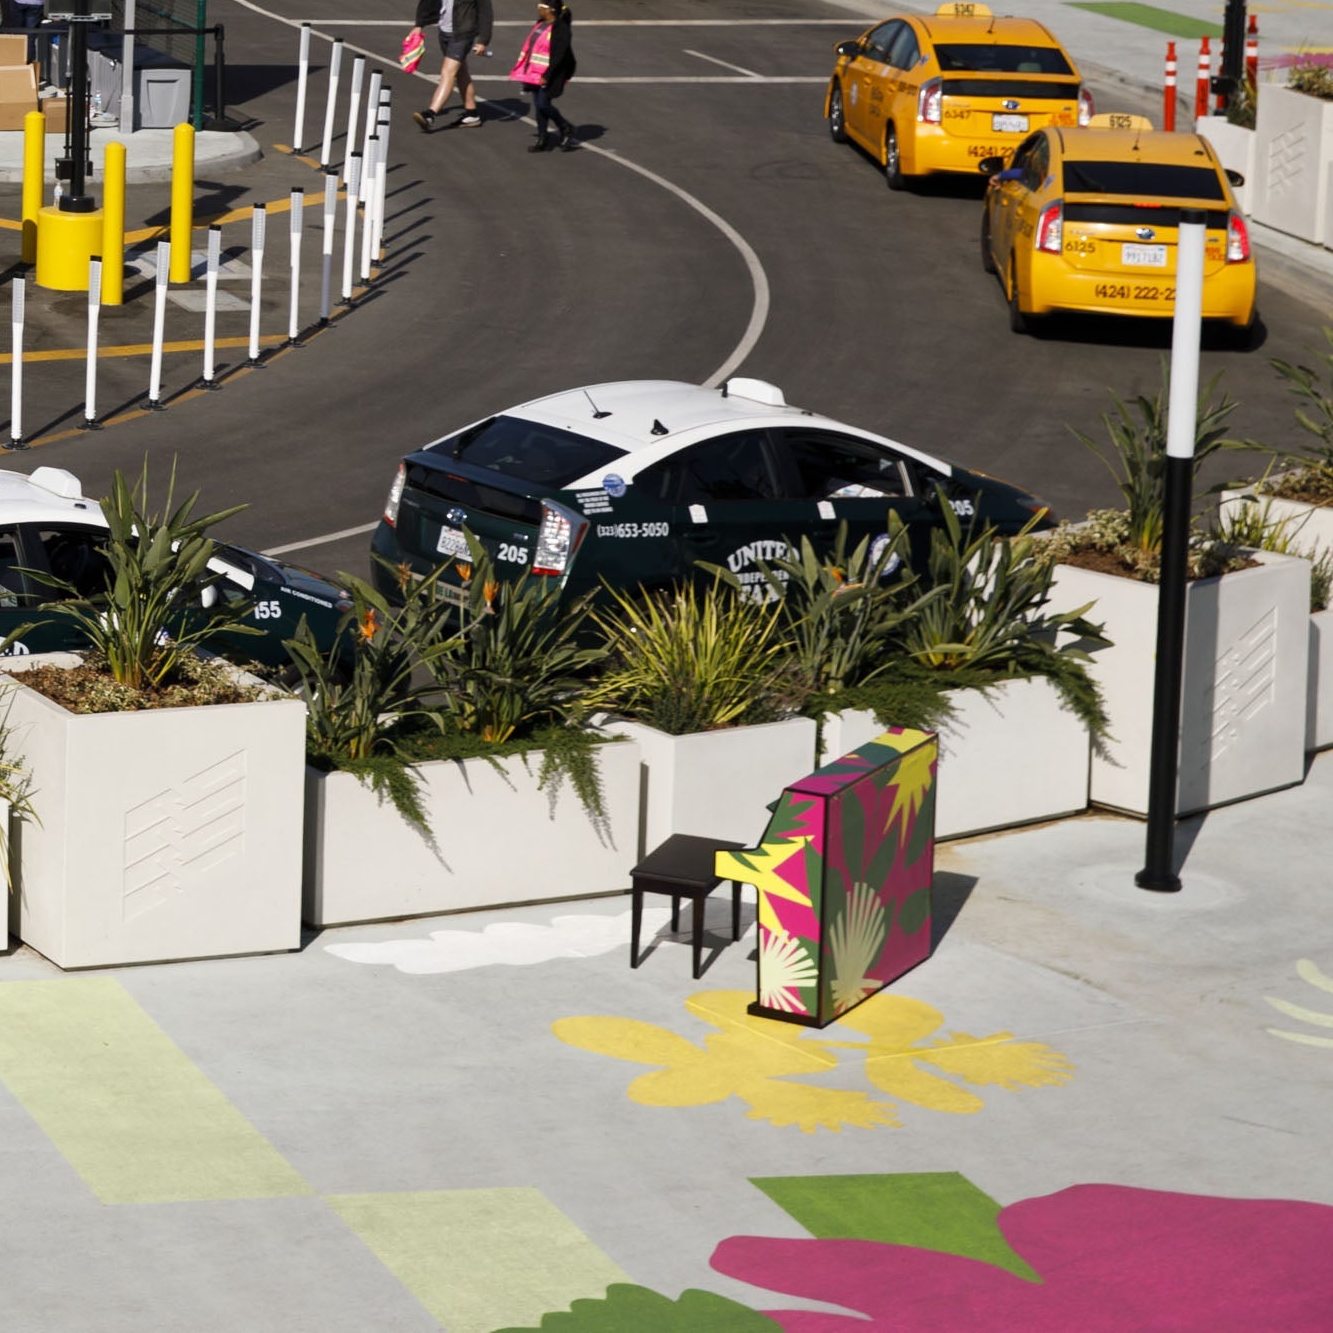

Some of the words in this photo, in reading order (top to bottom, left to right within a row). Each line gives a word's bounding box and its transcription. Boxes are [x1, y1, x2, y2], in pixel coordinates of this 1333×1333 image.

[944, 110, 972, 120] 6347
[1109, 115, 1132, 128] 6125
[968, 146, 998, 158] (424)
[1065, 242, 1096, 254] 6125
[1095, 285, 1130, 299] (424)
[1134, 286, 1175, 301] 222-22
[497, 542, 529, 565] 205
[292, 590, 333, 609] CONDITIONED
